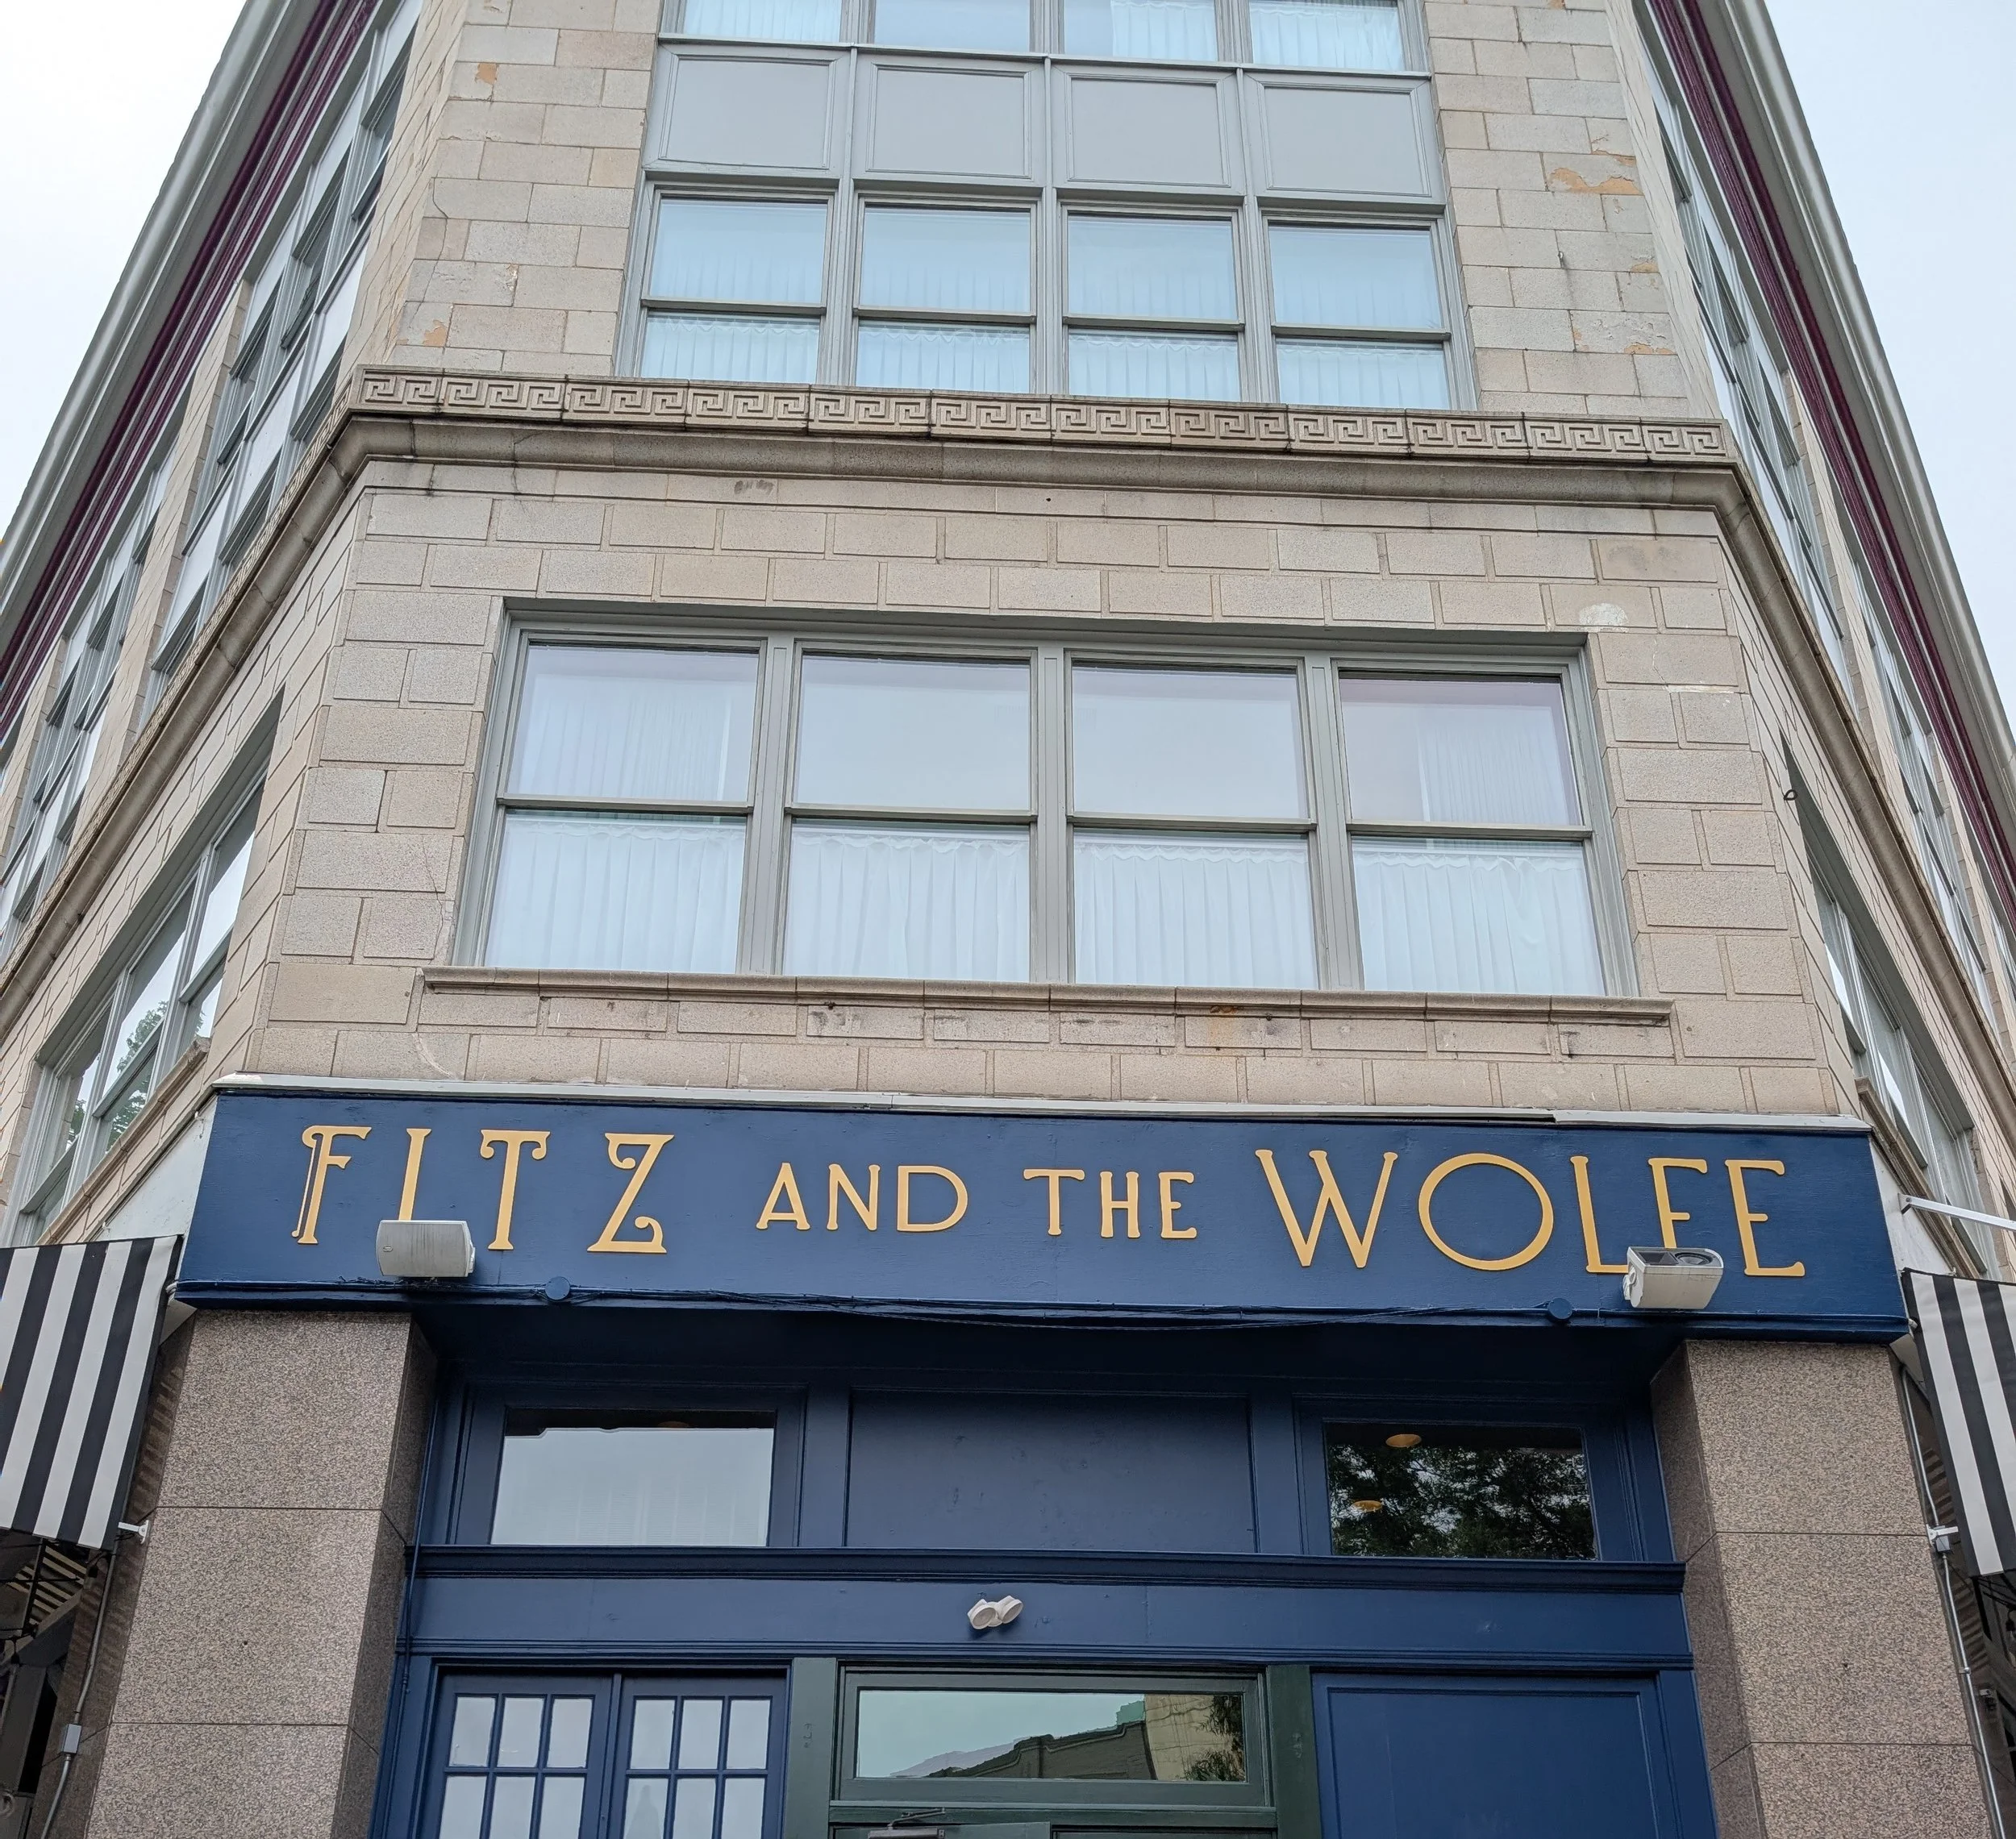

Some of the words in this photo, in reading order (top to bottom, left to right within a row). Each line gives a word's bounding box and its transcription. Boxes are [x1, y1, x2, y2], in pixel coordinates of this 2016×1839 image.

[291, 1125, 674, 1254] FITZ
[755, 1163, 968, 1233] AND
[1023, 1168, 1198, 1240] THE
[1255, 1149, 1806, 1278] WOLFE
